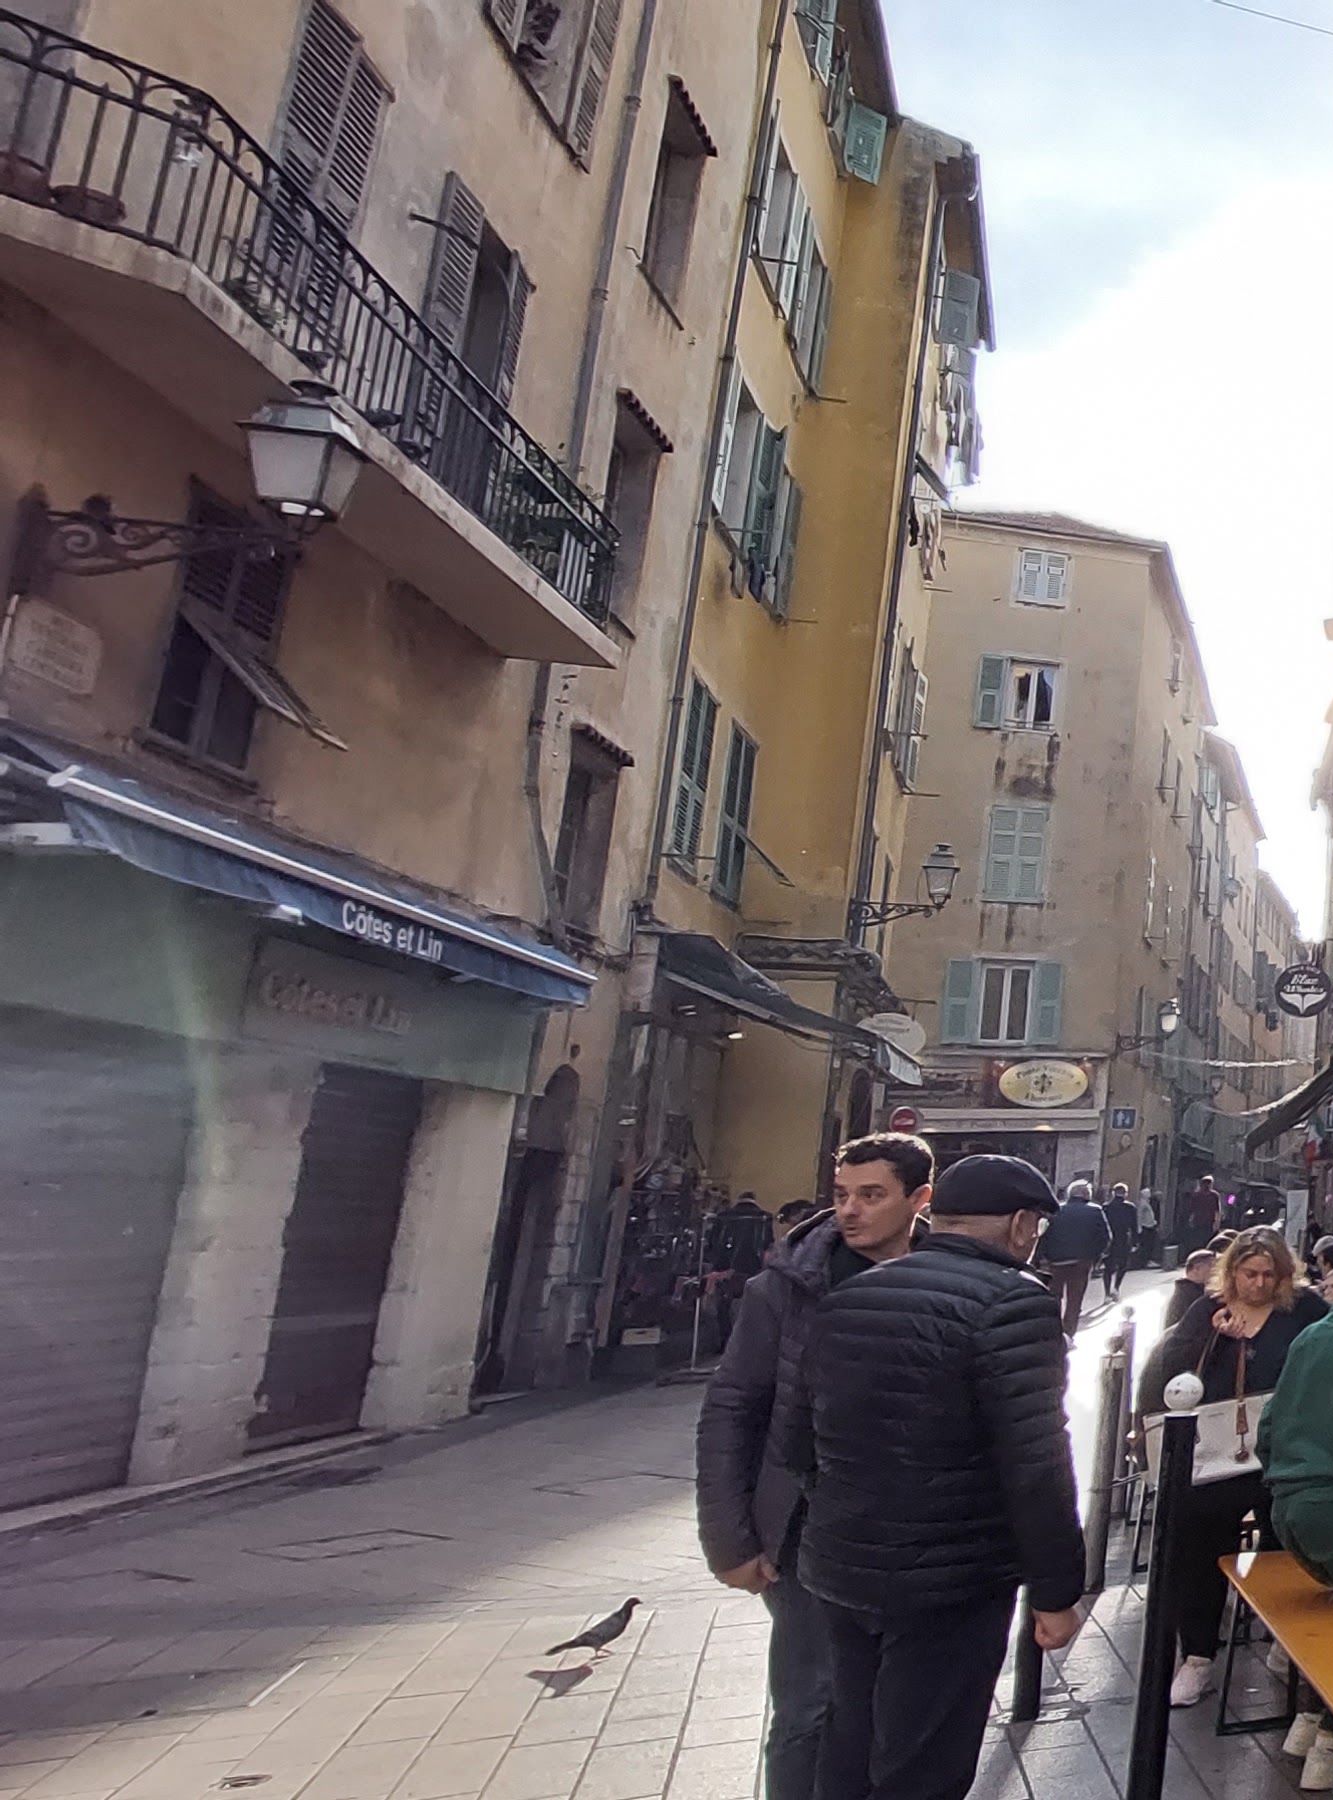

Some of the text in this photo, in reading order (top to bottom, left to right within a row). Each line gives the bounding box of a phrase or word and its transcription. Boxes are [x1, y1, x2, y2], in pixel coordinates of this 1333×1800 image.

[342, 900, 443, 961] Côtes et Lin
